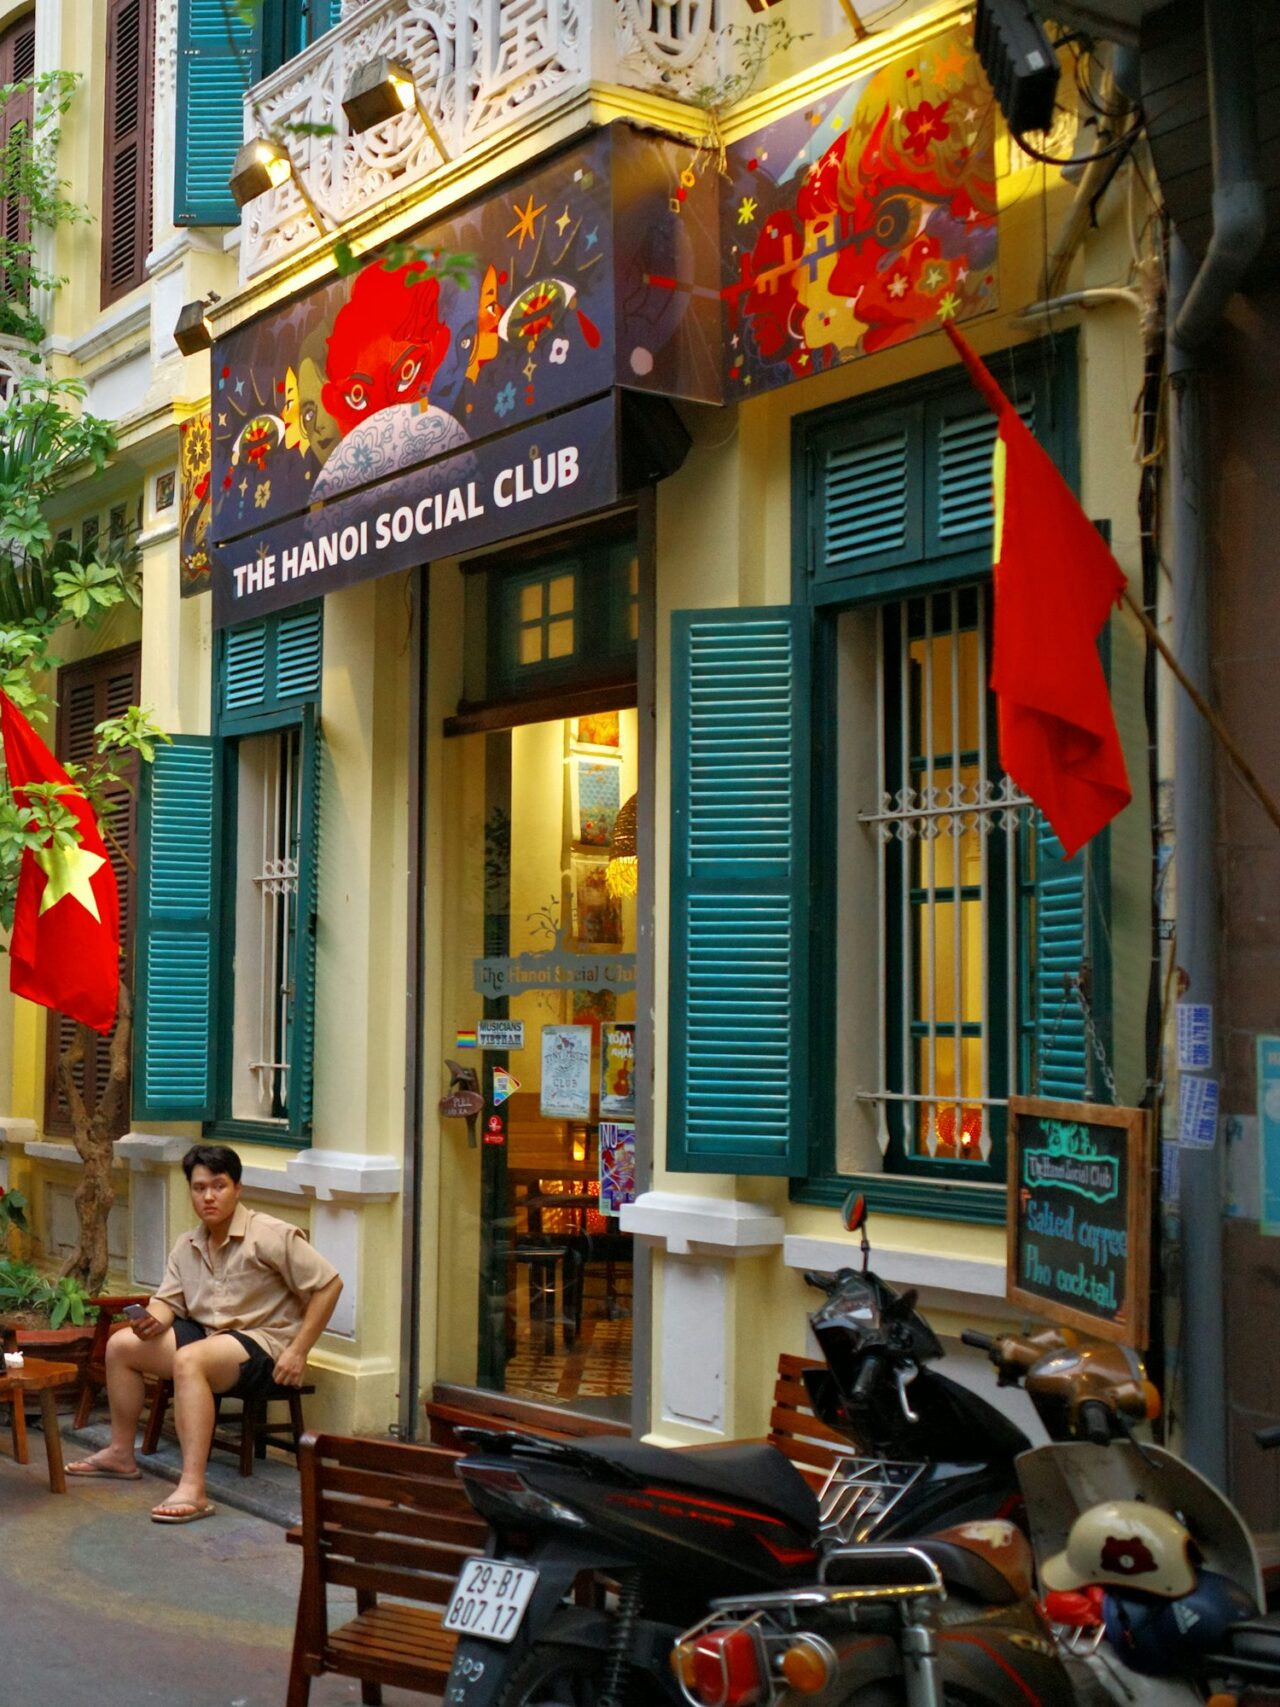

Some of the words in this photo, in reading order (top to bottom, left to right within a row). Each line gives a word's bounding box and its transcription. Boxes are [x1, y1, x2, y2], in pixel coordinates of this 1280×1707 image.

[233, 553, 276, 599] THE
[281, 520, 368, 582] HANOI
[375, 481, 484, 550] SOCIAL
[493, 445, 580, 509] CLUB
[466, 1565, 524, 1601] 29-B1
[449, 1596, 518, 1635] 807.17
